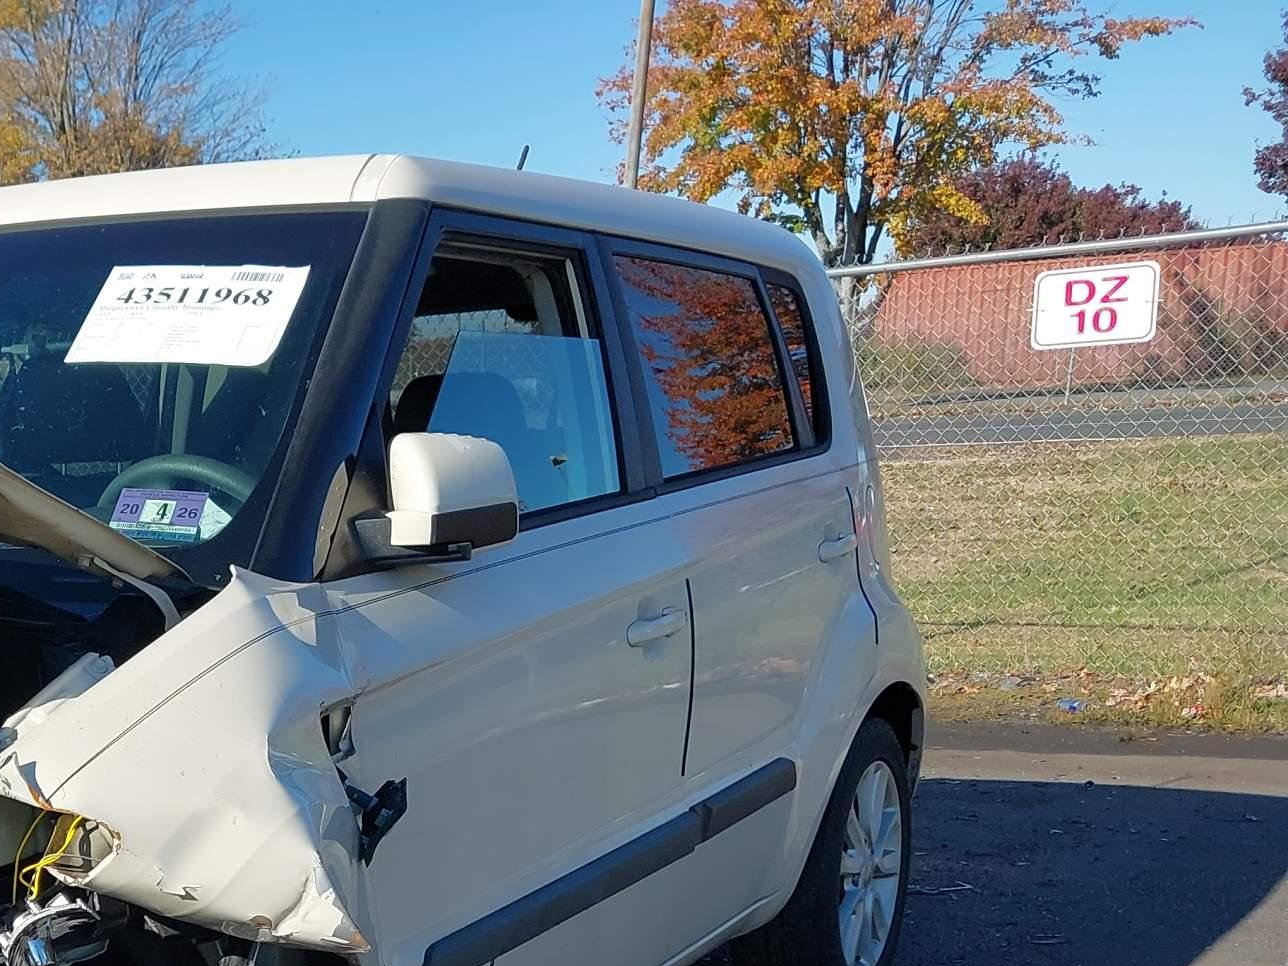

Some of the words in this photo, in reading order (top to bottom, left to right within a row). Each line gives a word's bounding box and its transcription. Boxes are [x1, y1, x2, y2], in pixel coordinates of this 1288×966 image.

[117, 287, 273, 306] 43511968
[1065, 275, 1129, 306] DZ
[1070, 307, 1118, 334] 10
[119, 503, 140, 516] 20
[155, 502, 169, 521] 4
[176, 507, 200, 520] 26
